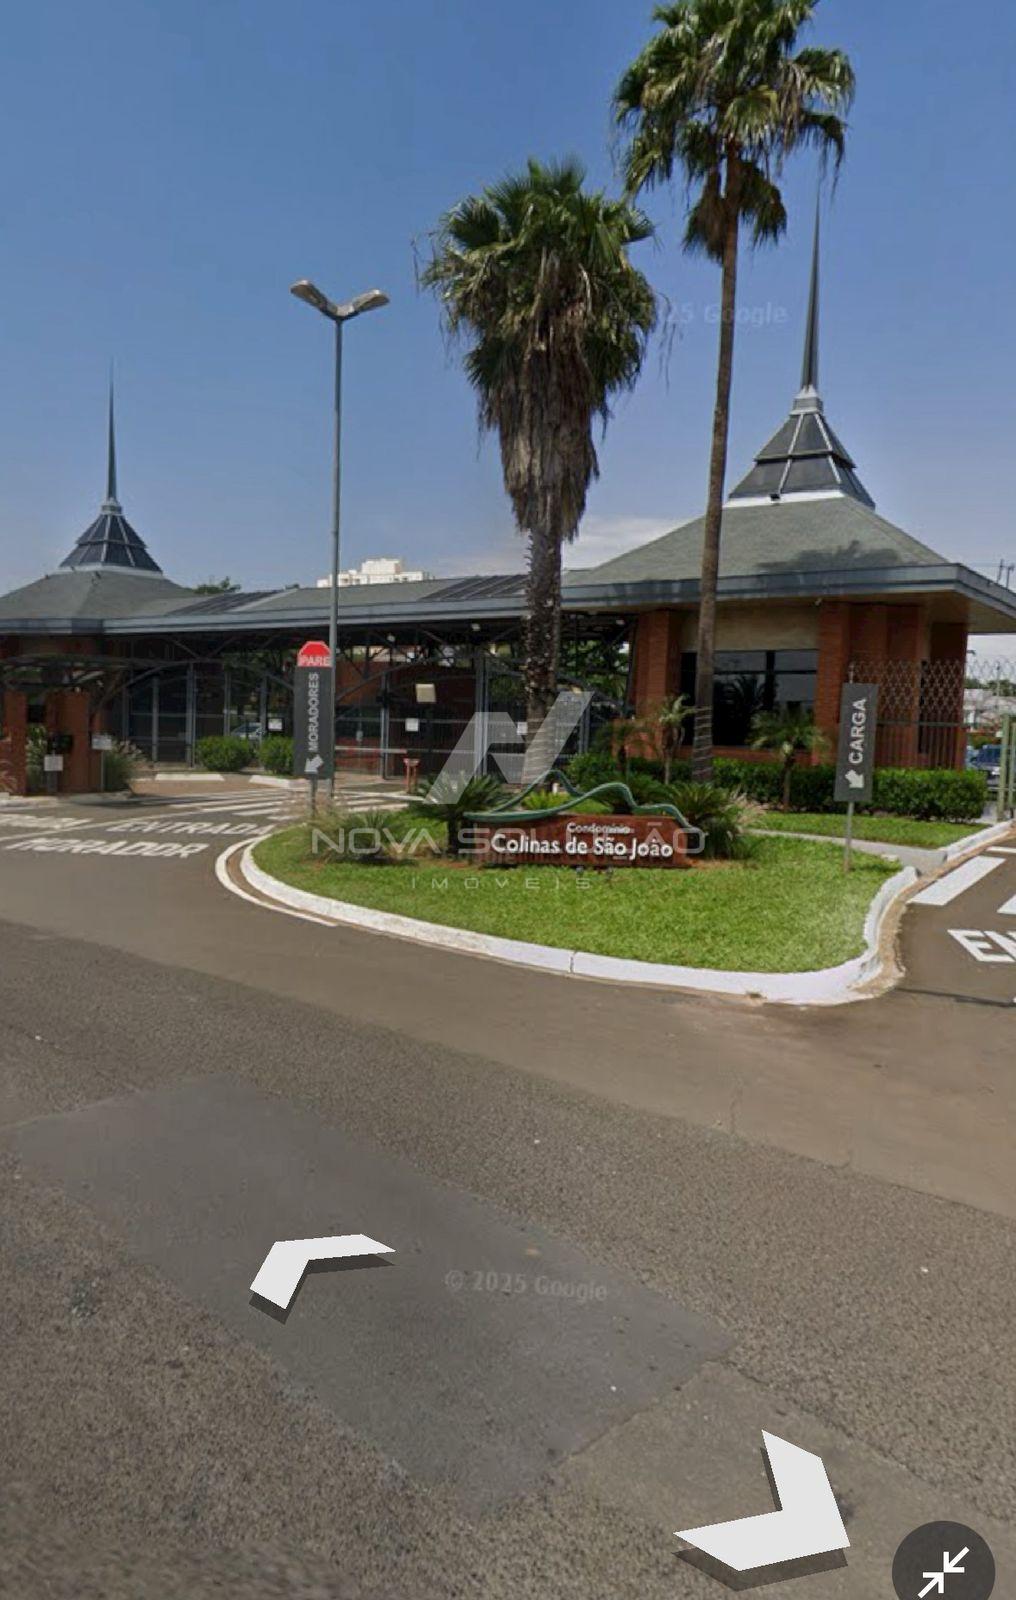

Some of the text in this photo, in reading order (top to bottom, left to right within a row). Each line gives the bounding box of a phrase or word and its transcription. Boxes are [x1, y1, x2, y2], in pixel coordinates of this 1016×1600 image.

[300, 655, 332, 667] PARE
[308, 671, 320, 753] MORADORES
[848, 698, 866, 764] CARGA
[491, 834, 673, 860] Colinas de São João
